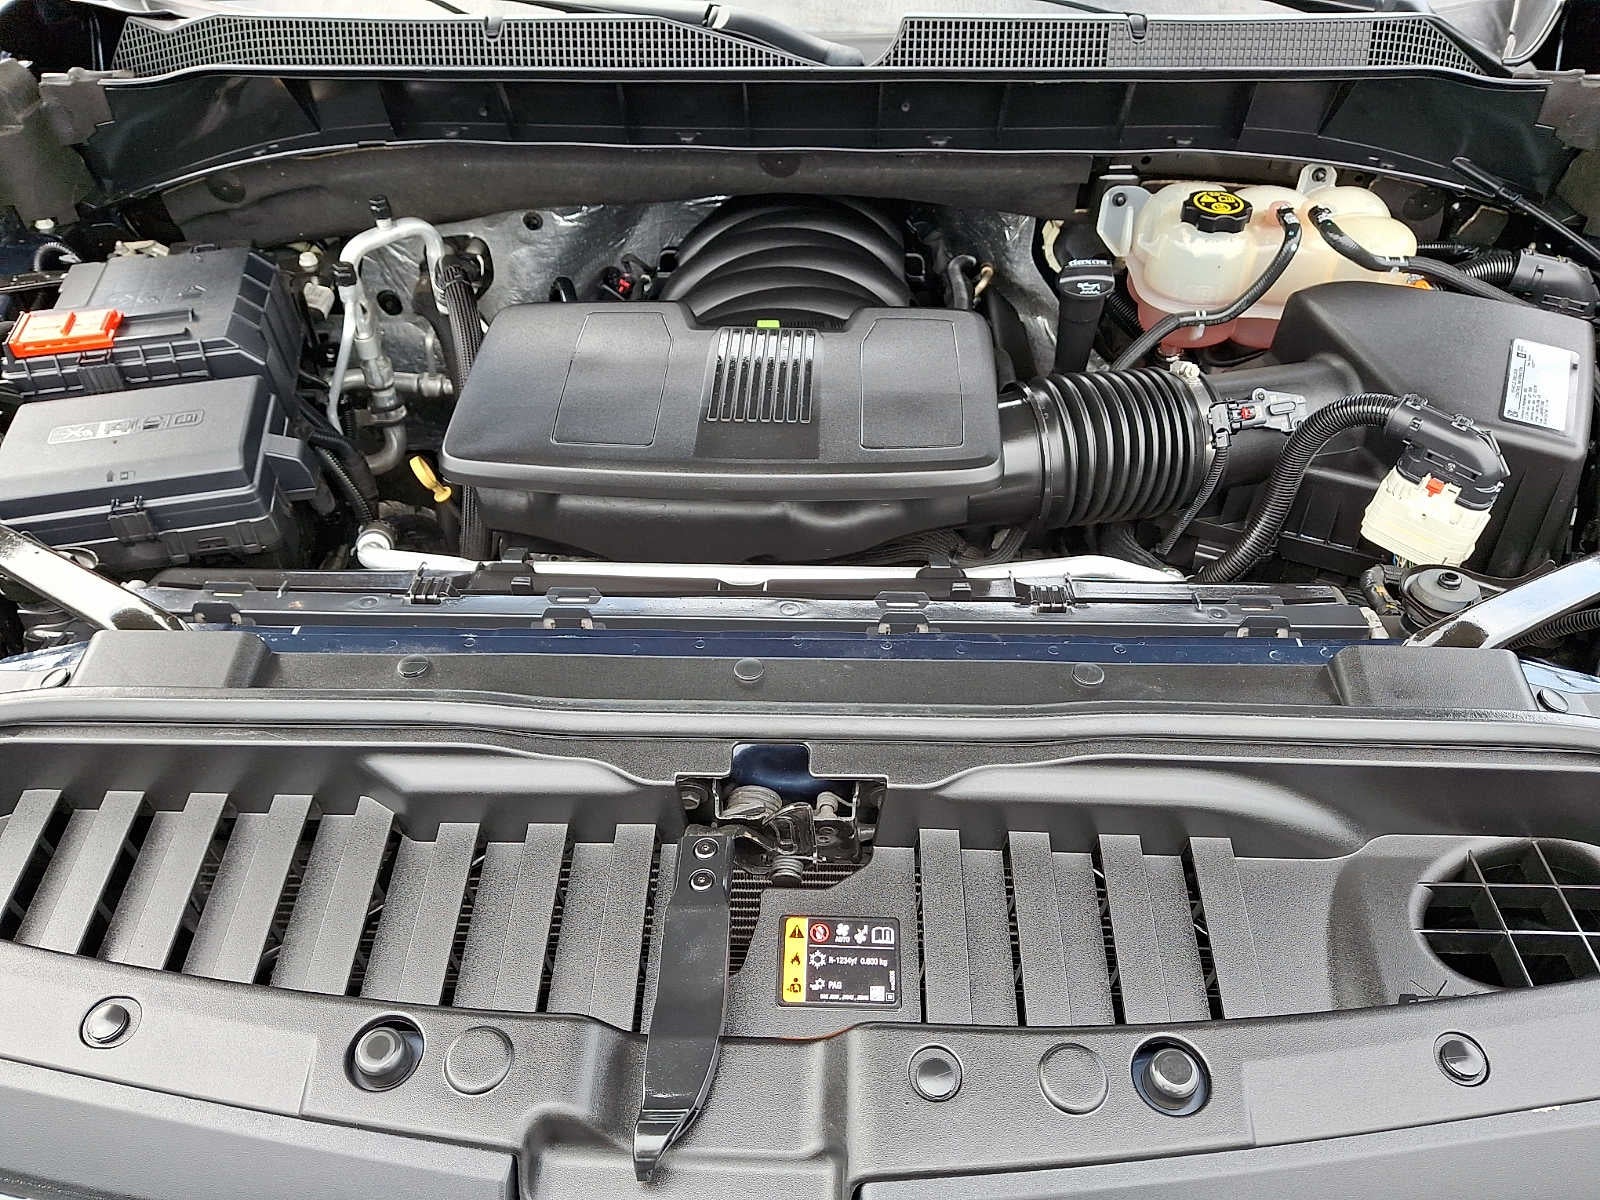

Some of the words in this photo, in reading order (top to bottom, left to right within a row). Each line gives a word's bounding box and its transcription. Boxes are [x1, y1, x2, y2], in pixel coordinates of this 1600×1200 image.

[835, 935, 851, 943] AUTO
[828, 955, 858, 966] R-1234yf
[879, 958, 888, 967] kg
[828, 980, 842, 990] PAG
